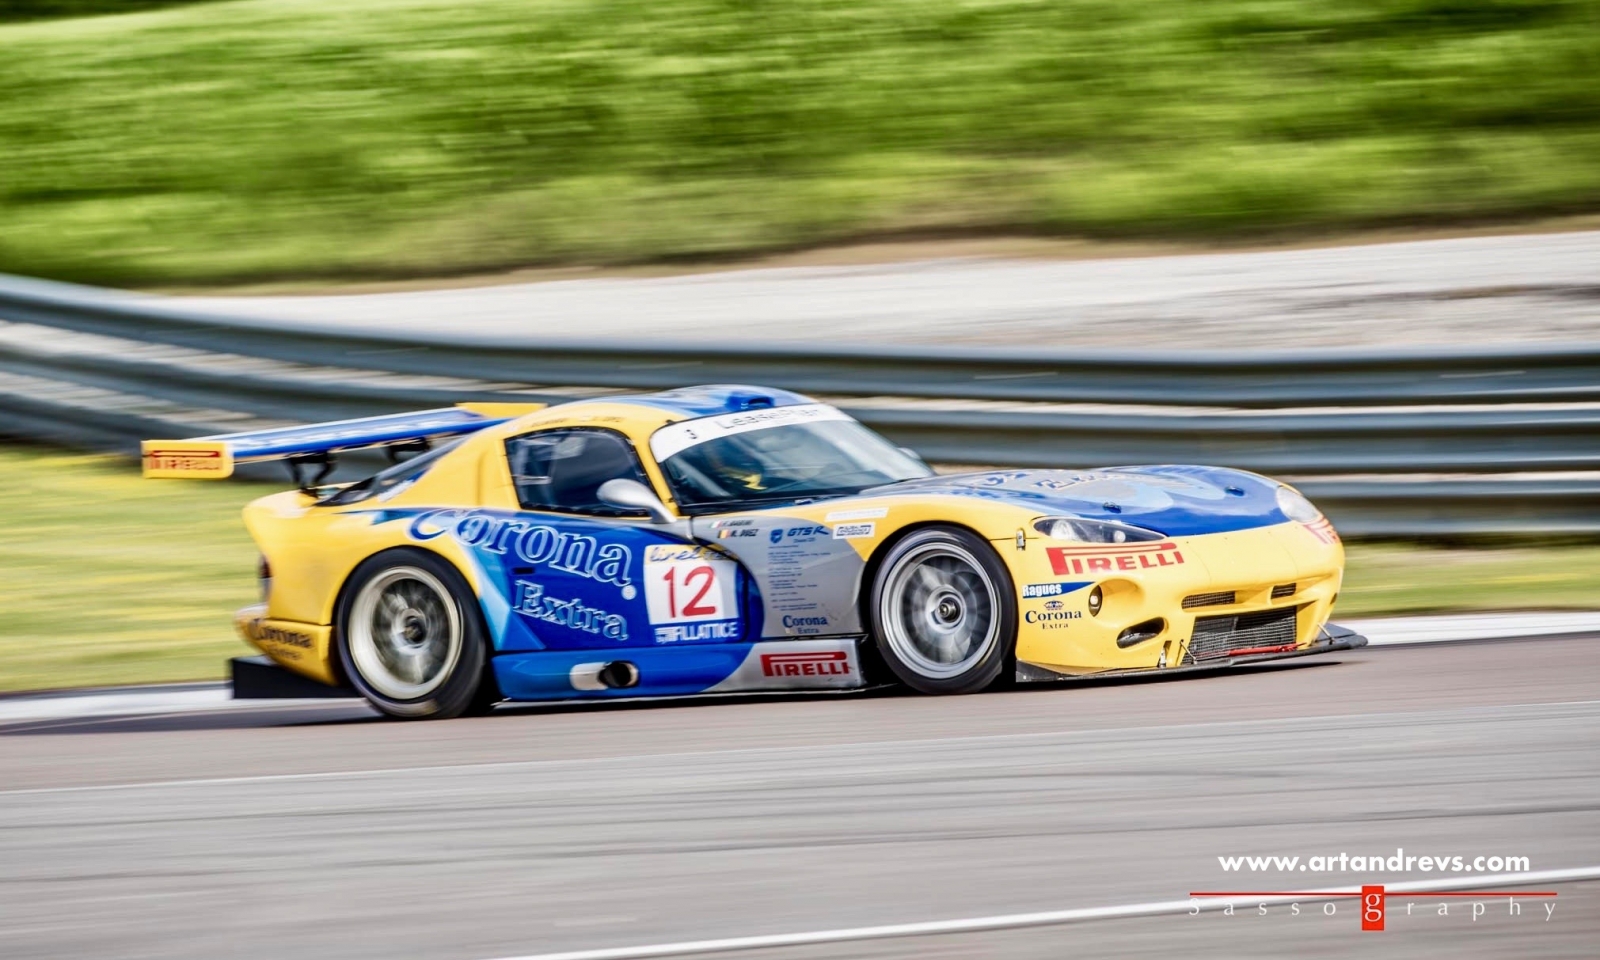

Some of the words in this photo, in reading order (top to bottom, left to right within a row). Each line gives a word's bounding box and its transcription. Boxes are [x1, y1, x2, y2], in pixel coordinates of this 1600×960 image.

[715, 408, 819, 430] LeasePan
[408, 507, 634, 588] Corona
[1046, 542, 1185, 576] PIRELLI
[663, 566, 717, 618] 12
[1022, 583, 1063, 597] Ragues
[513, 578, 630, 641] Extra
[782, 615, 828, 628] Corona
[1025, 610, 1082, 624] Corona
[1042, 622, 1069, 630] Extra
[760, 651, 850, 677] PIRELLI
